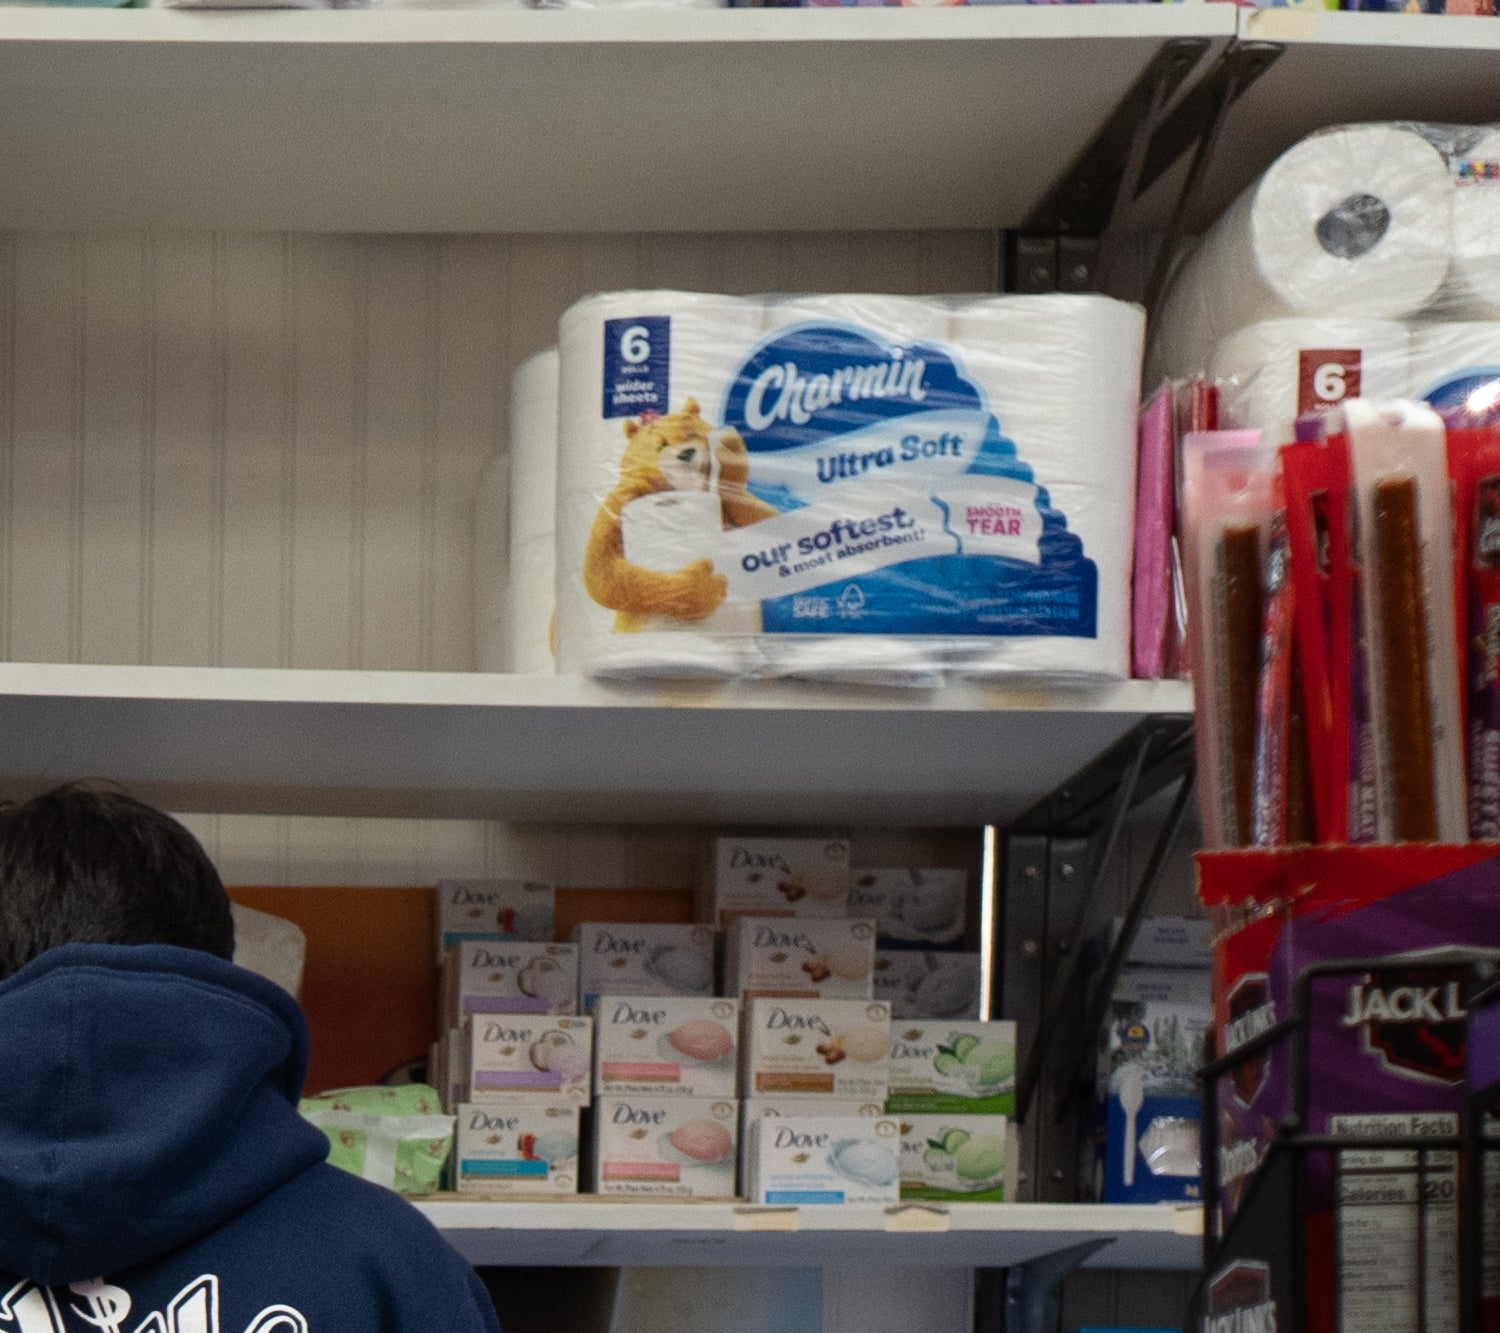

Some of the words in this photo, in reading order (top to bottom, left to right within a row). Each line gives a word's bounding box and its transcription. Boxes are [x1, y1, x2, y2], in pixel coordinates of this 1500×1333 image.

[620, 325, 652, 364] 6
[744, 348, 928, 432] Charmin
[1312, 362, 1348, 404] 6
[815, 446, 894, 484] Ultra
[900, 433, 963, 461] Soft
[966, 519, 1021, 536] TEAR
[741, 542, 793, 574] our
[472, 948, 520, 969] Dove
[1341, 973, 1445, 1028] JACK
[612, 1003, 666, 1025] Dove
[767, 1008, 822, 1030] Dove
[484, 1022, 533, 1043] Dove
[470, 1111, 518, 1131] Dove
[613, 1103, 665, 1125] Dove
[775, 1126, 829, 1148] Dove
